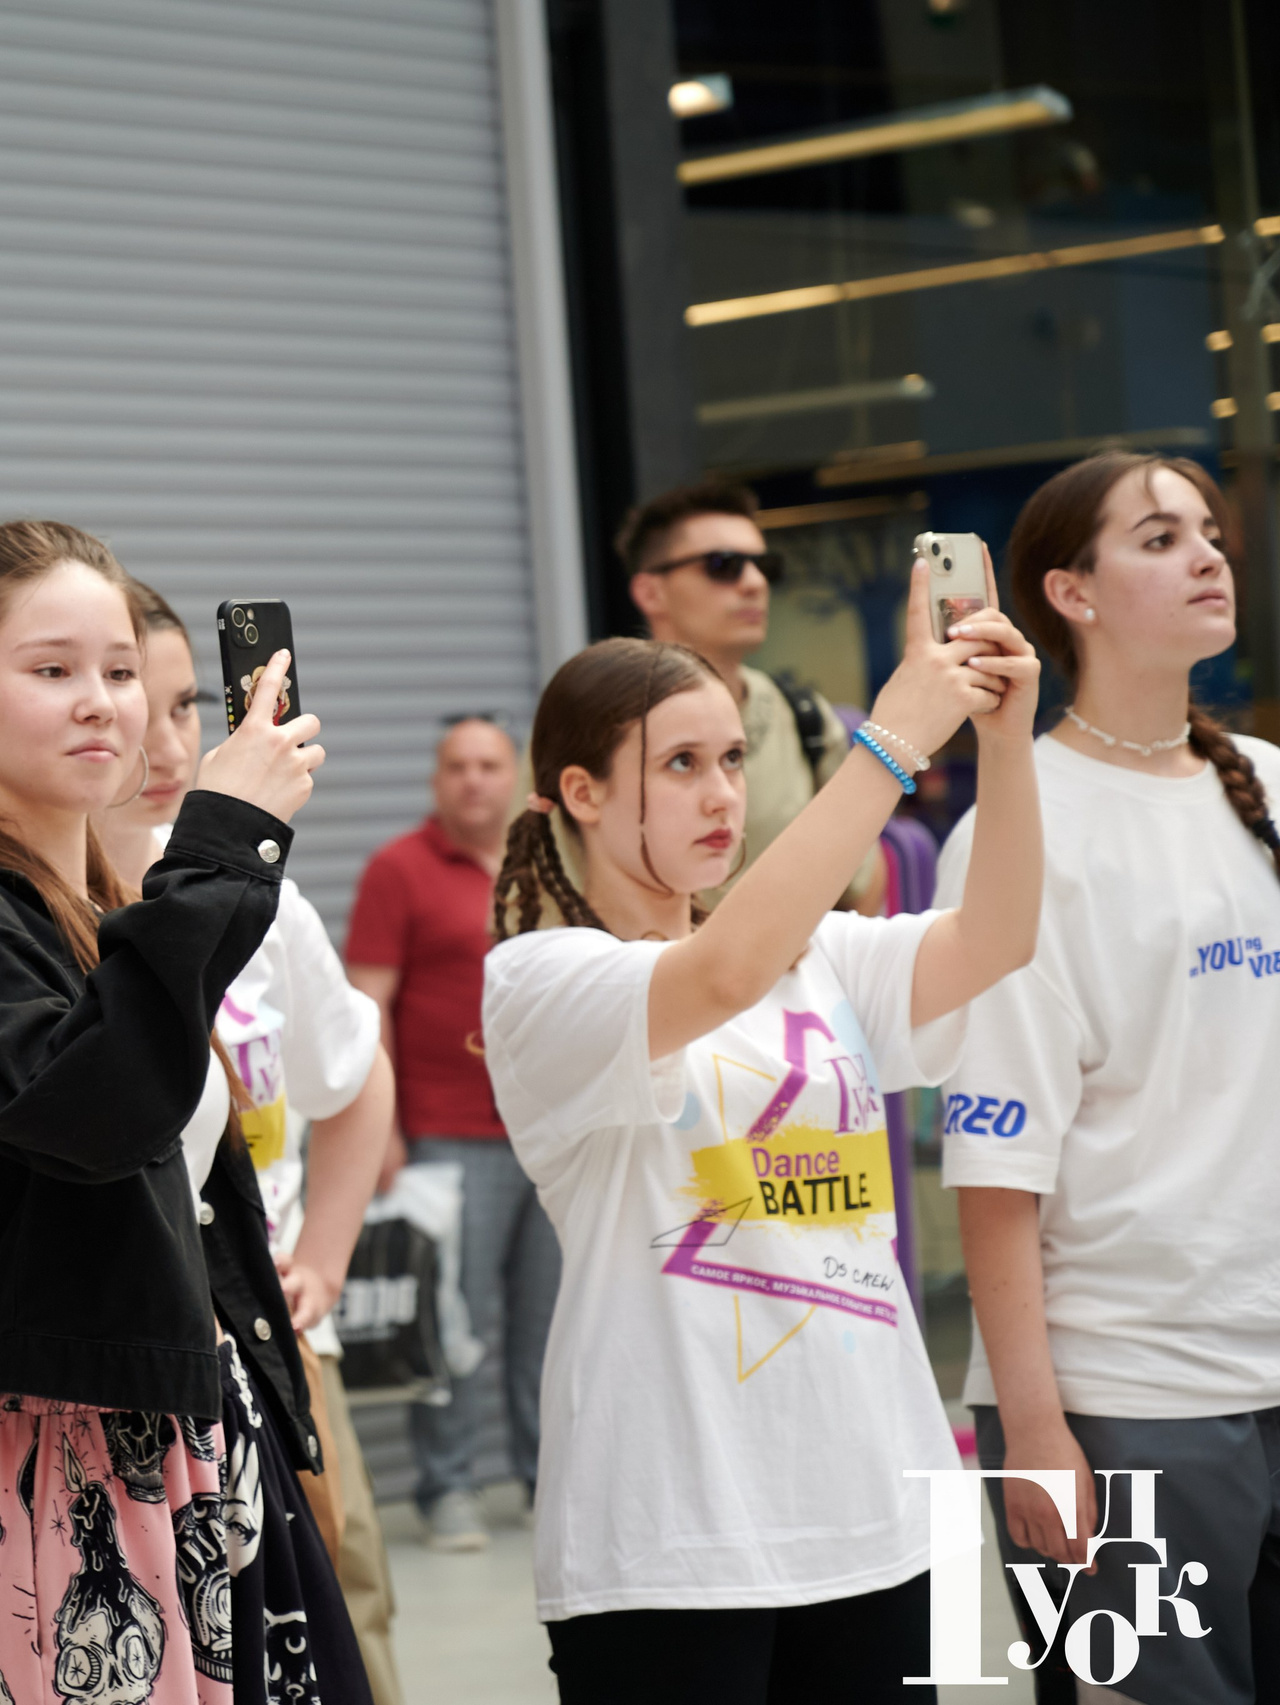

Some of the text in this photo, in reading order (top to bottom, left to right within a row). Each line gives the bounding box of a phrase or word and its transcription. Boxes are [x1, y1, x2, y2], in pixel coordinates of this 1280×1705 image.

[751, 1147, 840, 1178] Dance
[758, 1173, 872, 1215] BATTLE
[690, 1264, 730, 1282] САМОЕ
